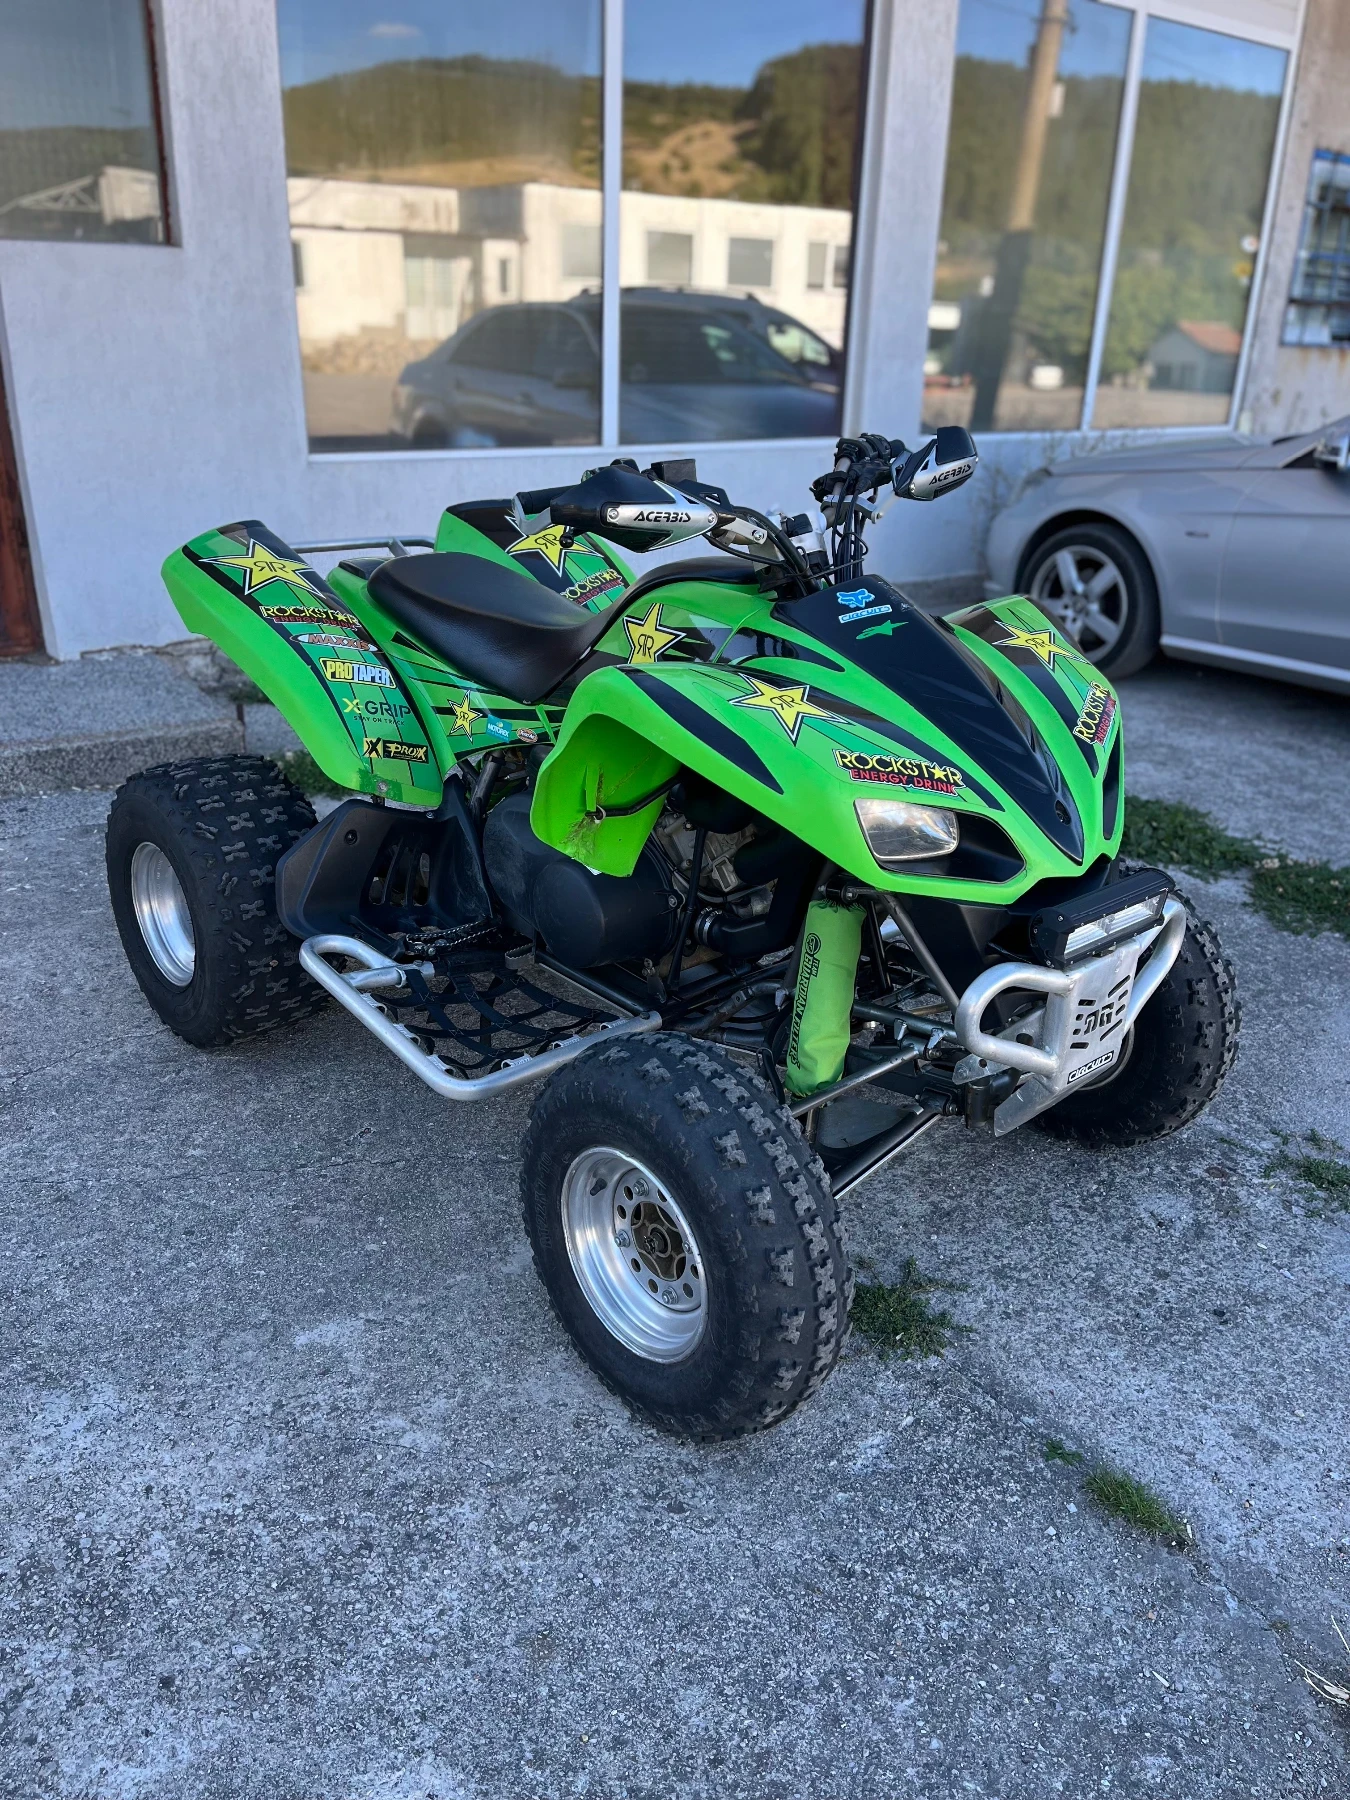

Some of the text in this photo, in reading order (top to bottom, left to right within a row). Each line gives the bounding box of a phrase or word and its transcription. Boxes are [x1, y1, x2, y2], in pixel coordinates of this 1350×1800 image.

[308, 634, 371, 650] MAXXIS
[851, 768, 956, 795] ENERGY DRINK
